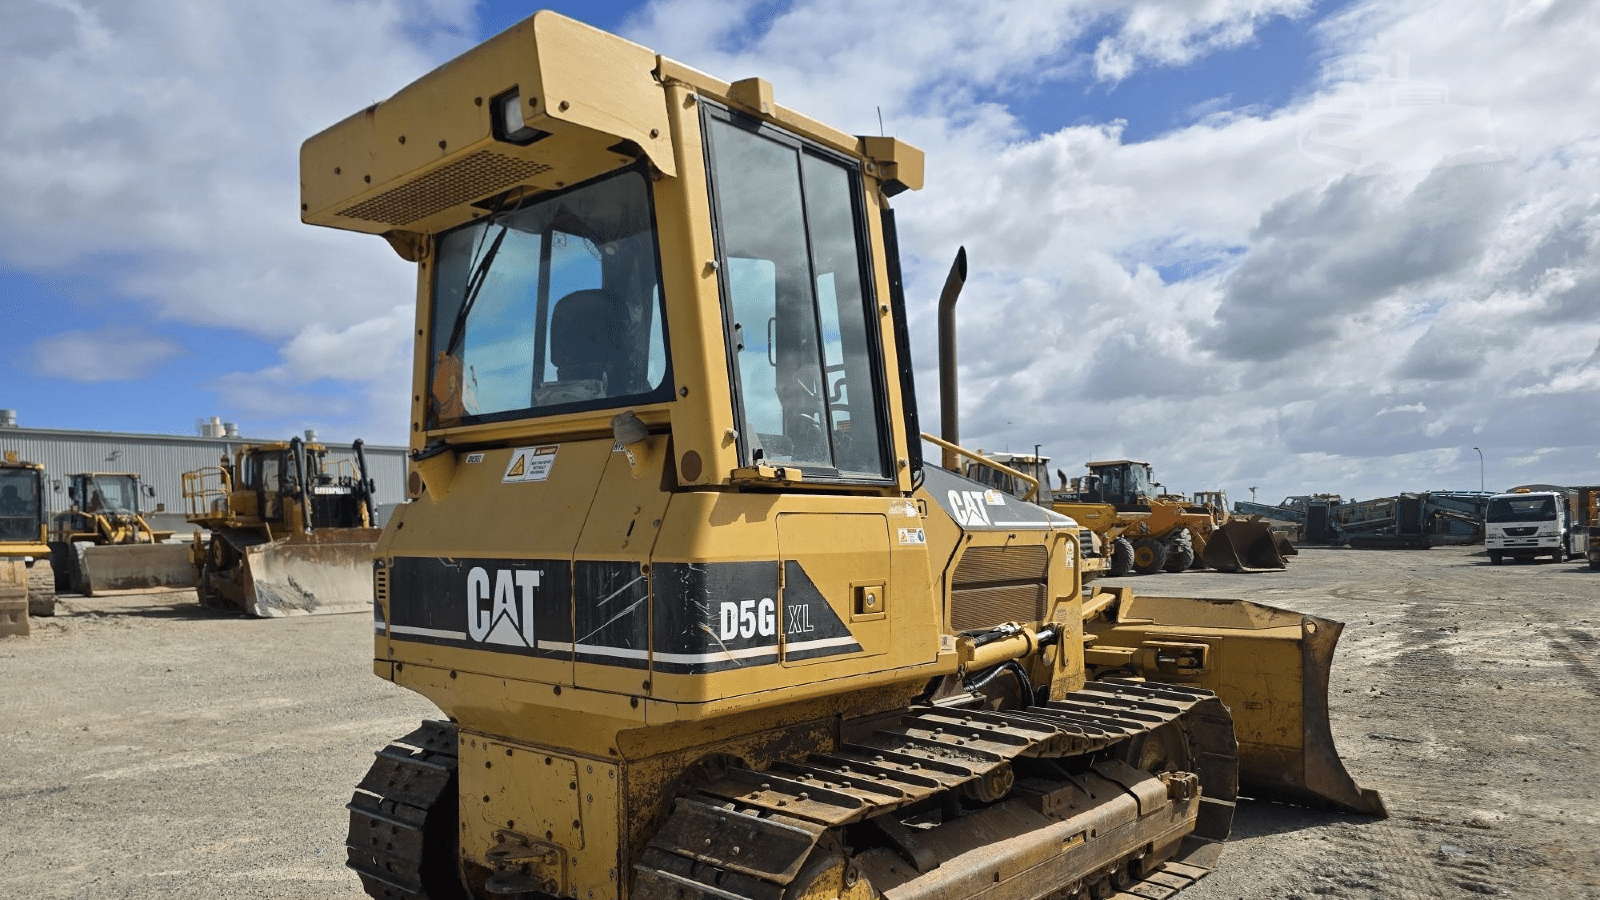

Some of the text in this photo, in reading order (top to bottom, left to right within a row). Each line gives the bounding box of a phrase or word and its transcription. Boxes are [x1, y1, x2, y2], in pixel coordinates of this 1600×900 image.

[947, 489, 991, 526] CAT
[720, 597, 815, 641] D5G XL
